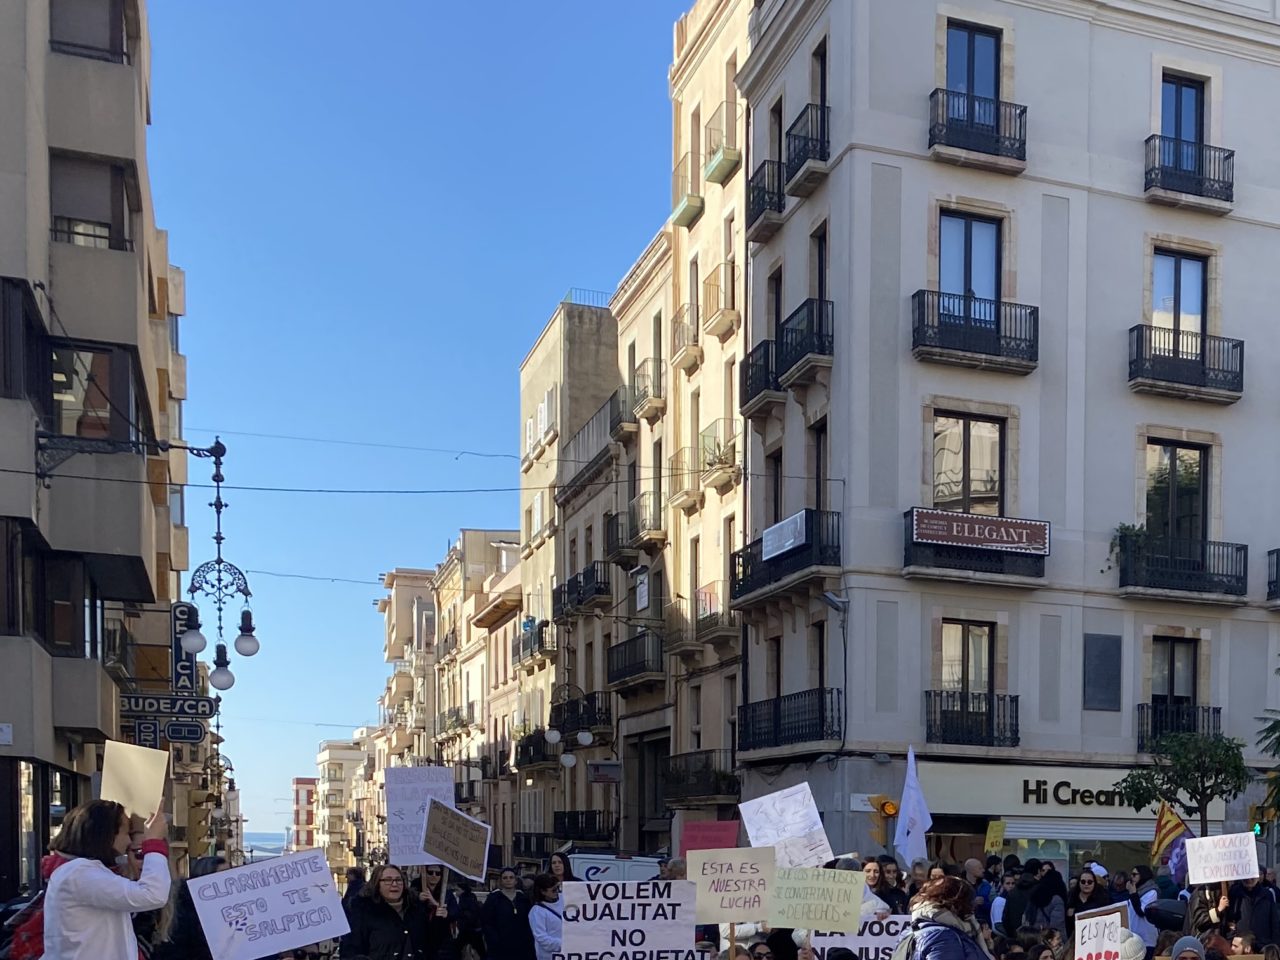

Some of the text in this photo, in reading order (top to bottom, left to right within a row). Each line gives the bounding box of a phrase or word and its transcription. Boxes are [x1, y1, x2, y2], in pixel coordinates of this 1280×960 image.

[952, 522, 1030, 543] ELEGANT
[1023, 780, 1047, 804] Hi
[198, 856, 323, 901] CLARAMENTE
[701, 862, 760, 876] ESTA ES
[586, 882, 672, 901] VOLEM
[708, 878, 767, 893] NUESTRA
[784, 887, 834, 903] CONVIERTAN
[837, 888, 852, 903] EN
[220, 887, 312, 923] ESTO TE
[720, 896, 762, 910] LUCHA
[786, 903, 840, 922] DERECHOS
[562, 903, 681, 923] QUALITAT
[245, 906, 333, 941] SALPICA
[611, 928, 646, 947] NO
[1080, 922, 1099, 946] ELS
